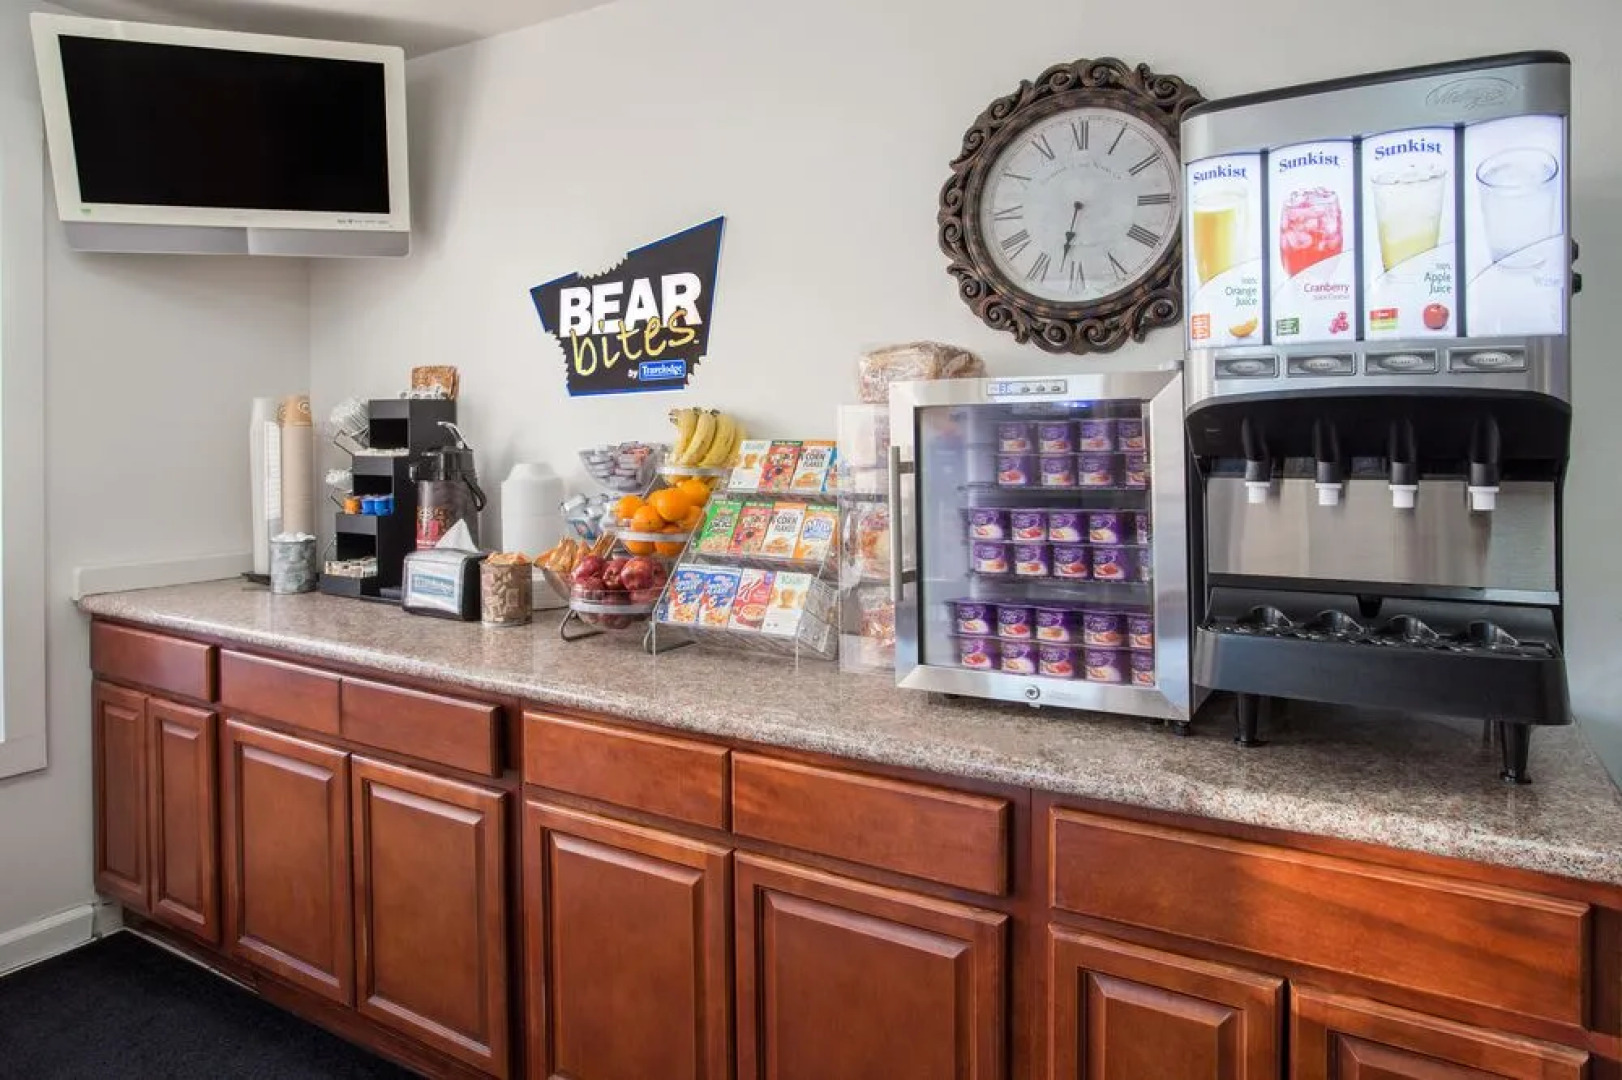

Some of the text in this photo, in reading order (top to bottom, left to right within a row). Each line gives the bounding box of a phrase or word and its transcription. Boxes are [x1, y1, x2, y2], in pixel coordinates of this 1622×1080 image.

[1375, 138, 1443, 161] Sunkist
[1279, 151, 1340, 173] Sunkist
[1192, 163, 1248, 185] Sunkist
[1424, 271, 1452, 285] Apple
[1224, 286, 1258, 298] Orange
[1303, 282, 1351, 294] Cranberry
[1428, 284, 1452, 296] Juice
[558, 271, 703, 338] BEAR
[1235, 297, 1258, 307] Juice
[570, 308, 697, 377] bites
[776, 514, 798, 525] CORN
